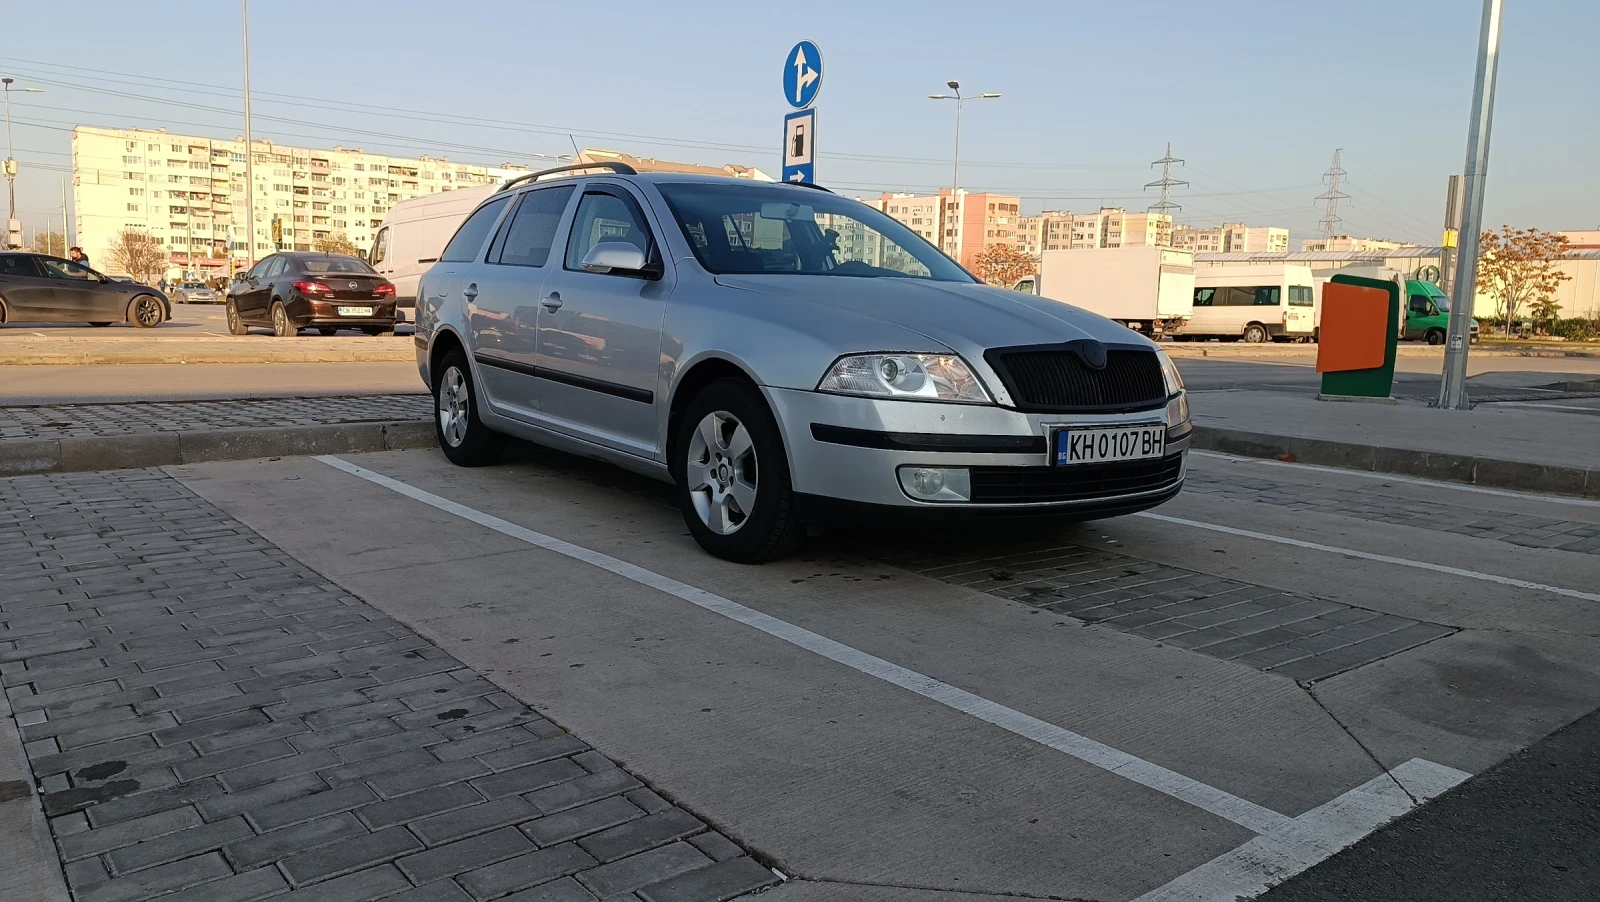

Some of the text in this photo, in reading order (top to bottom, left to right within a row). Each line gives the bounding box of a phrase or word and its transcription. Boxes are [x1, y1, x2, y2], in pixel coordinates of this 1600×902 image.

[1070, 430, 1163, 460] KH 0107 BH
[1058, 452, 1066, 460] BG
